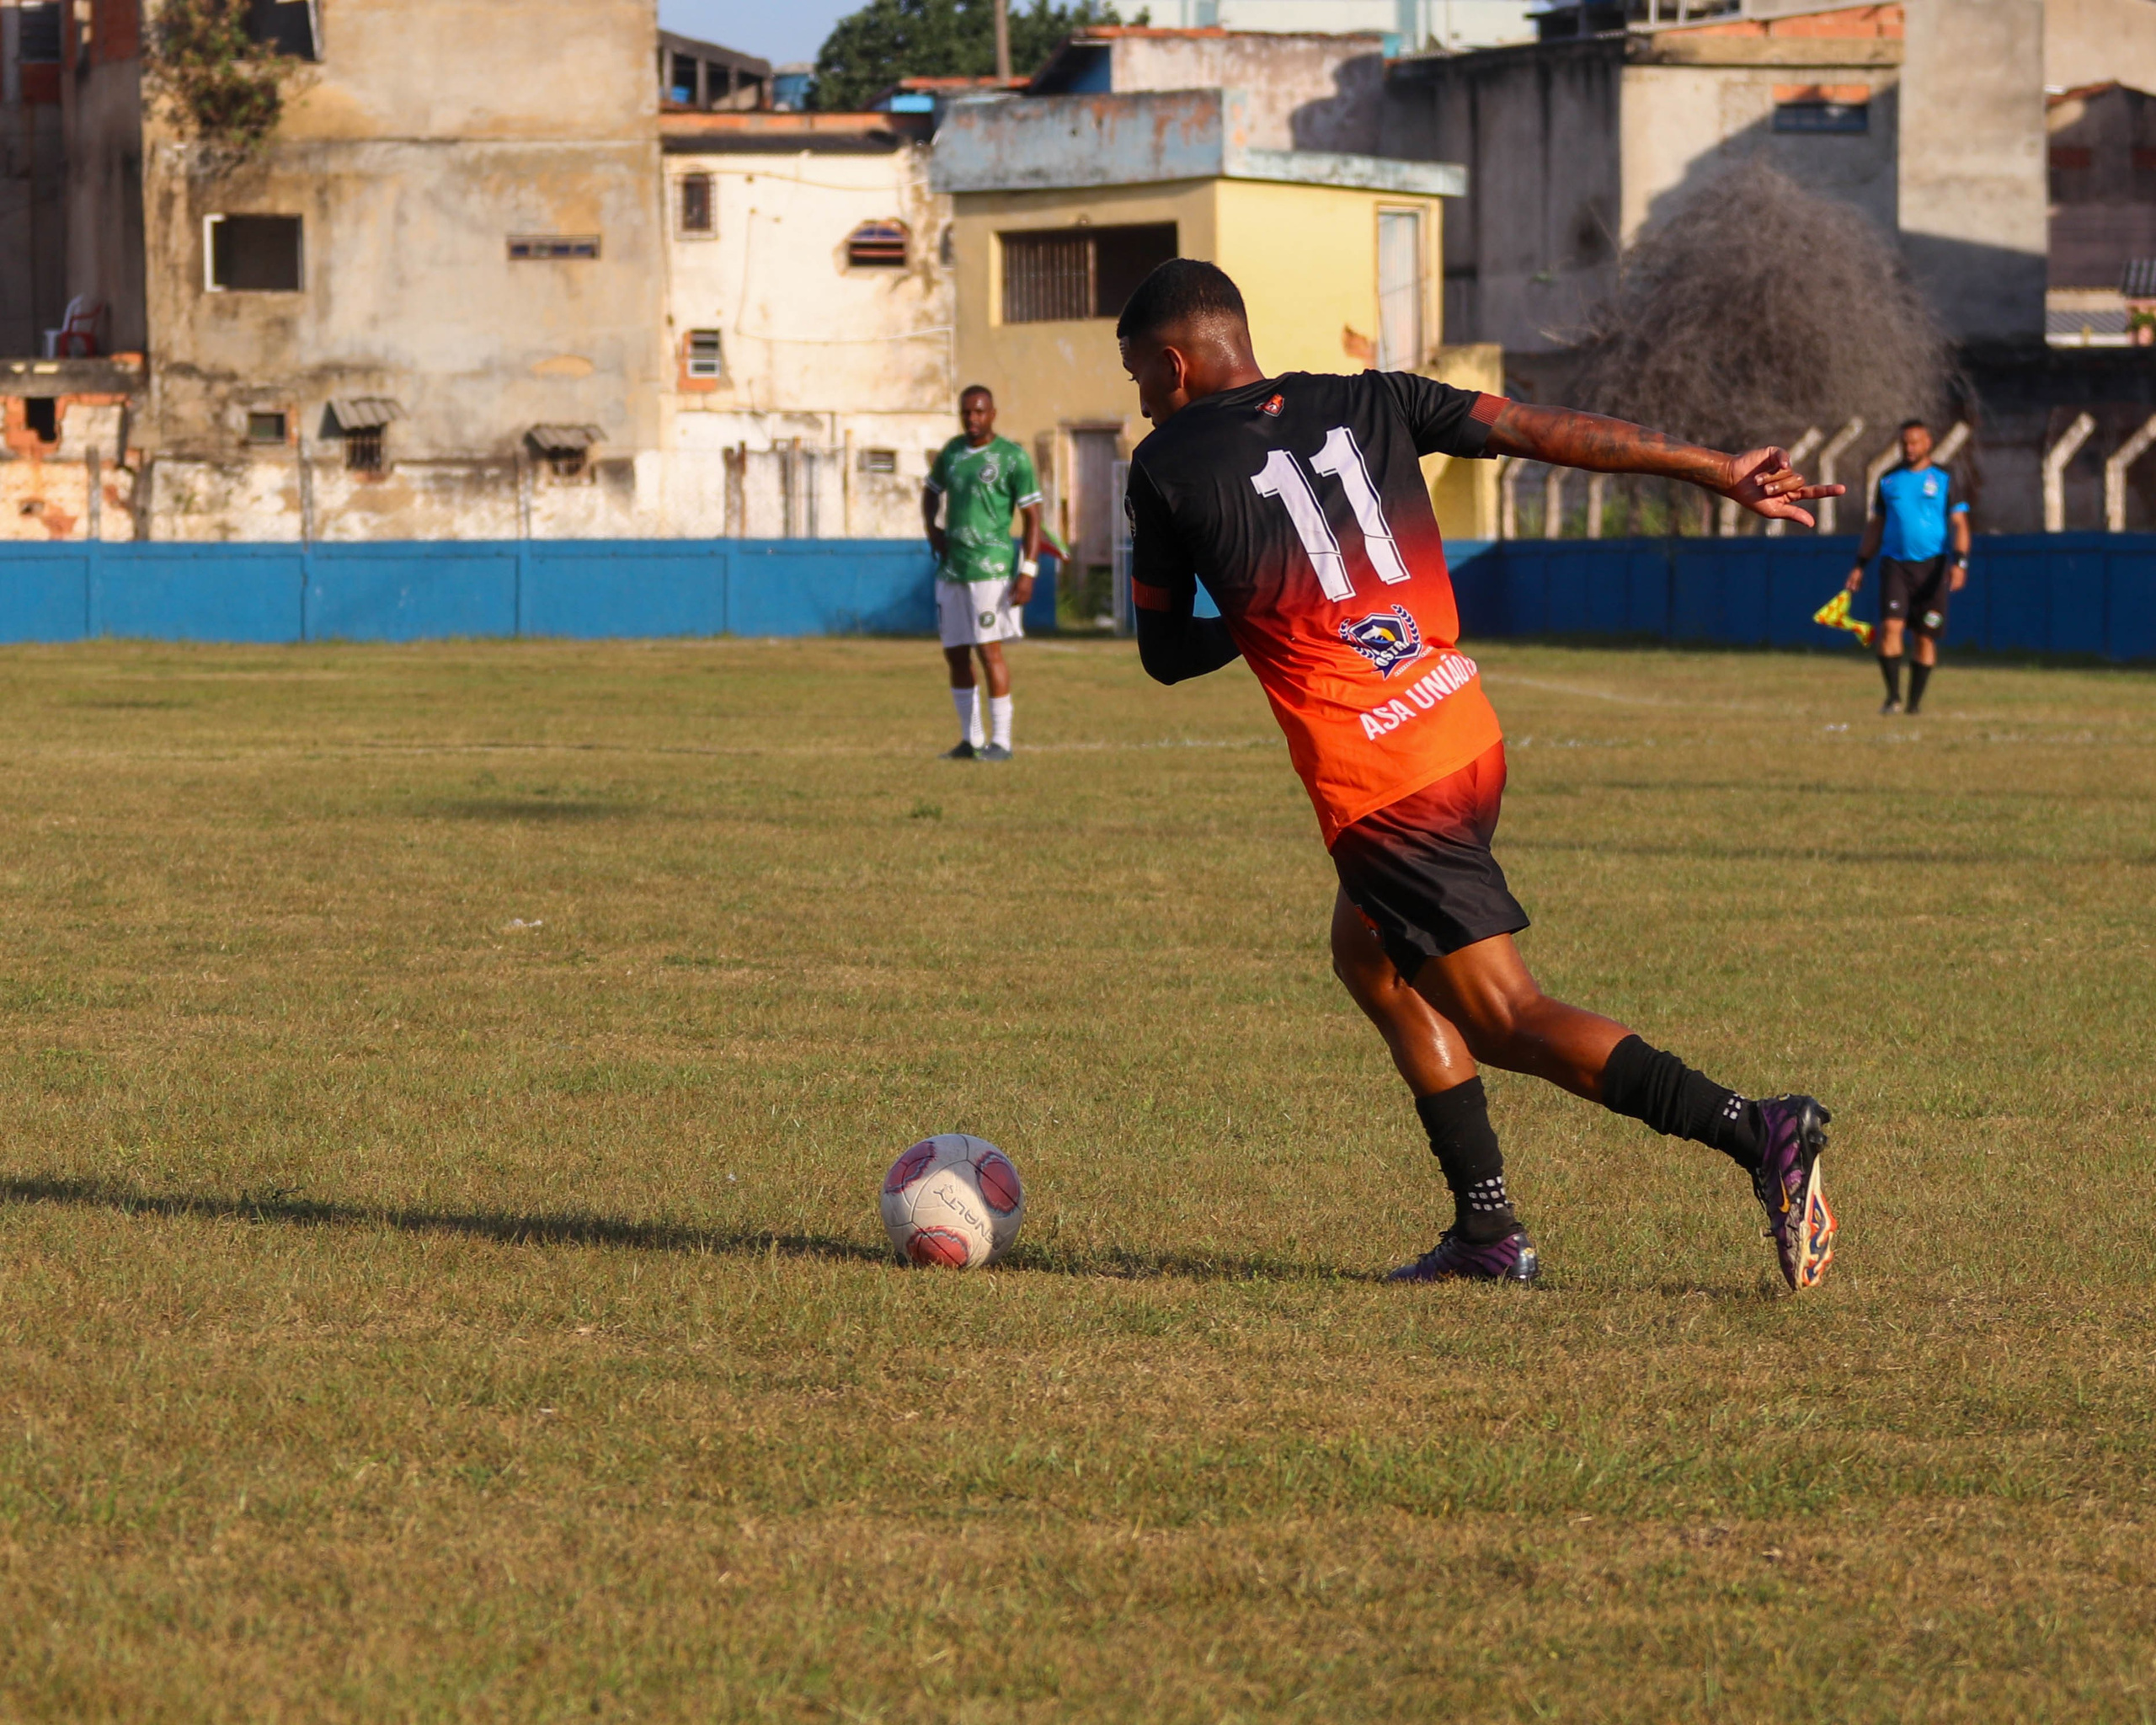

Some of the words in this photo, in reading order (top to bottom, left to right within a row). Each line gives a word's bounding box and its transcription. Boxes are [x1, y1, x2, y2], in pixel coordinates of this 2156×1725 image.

[1250, 425, 1412, 603] 11
[1358, 698, 1417, 741] ASA
[1404, 654, 1470, 709] UNIÃO
[933, 1189, 1006, 1251] PENALTY
